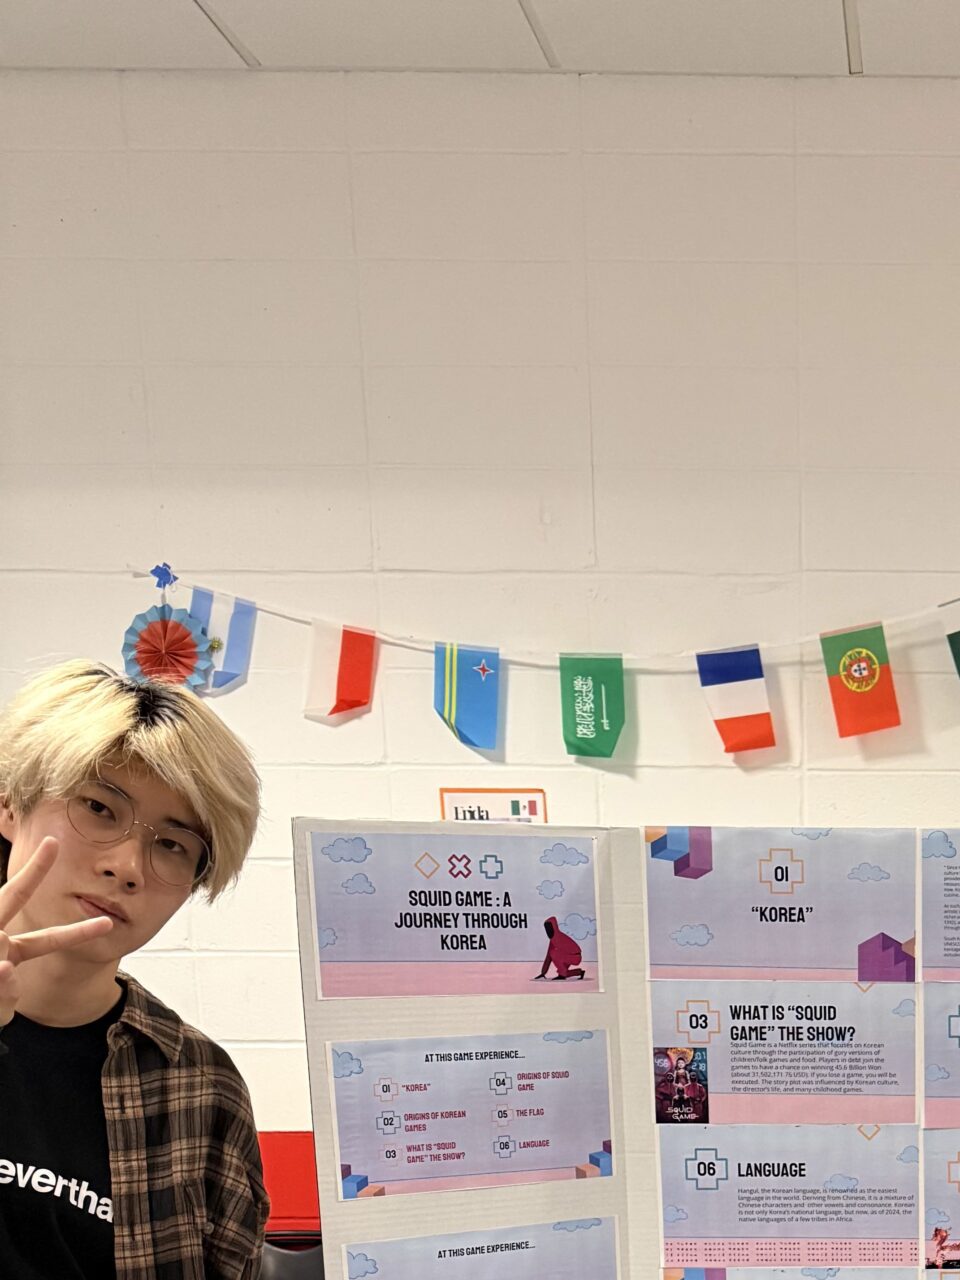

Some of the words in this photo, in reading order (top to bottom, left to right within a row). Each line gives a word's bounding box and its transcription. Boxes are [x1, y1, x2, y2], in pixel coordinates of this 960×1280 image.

[775, 867, 788, 882] 01
[409, 891, 451, 907] SQUID
[455, 891, 492, 906] GAME
[503, 892, 511, 906] A
[395, 914, 459, 929] JOURNEY
[463, 913, 528, 929] THROUGH
[752, 907, 812, 922] "KOREA"
[441, 935, 486, 950] KOREA
[689, 1015, 708, 1029] 03
[730, 1006, 768, 1021] WHAT
[772, 1006, 784, 1020] IS
[788, 1006, 836, 1021] "SQUID
[731, 1026, 774, 1041] GAME"
[779, 1026, 805, 1041] THE
[808, 1026, 855, 1041] SHOW?
[425, 1054, 434, 1062] AT
[436, 1053, 452, 1061] THIS
[454, 1052, 473, 1061] GAME
[383, 1118, 394, 1126] 02
[404, 1113, 429, 1121] ORIGINS
[440, 1111, 466, 1119] KOREAN
[405, 1124, 426, 1132] GAMES
[386, 1150, 396, 1158] 03
[406, 1144, 424, 1152] WHAT
[500, 1142, 509, 1150] 06
[519, 1139, 549, 1148] LANGUAGE
[697, 1162, 716, 1176] 06
[738, 1163, 806, 1177] LANGUAGE
